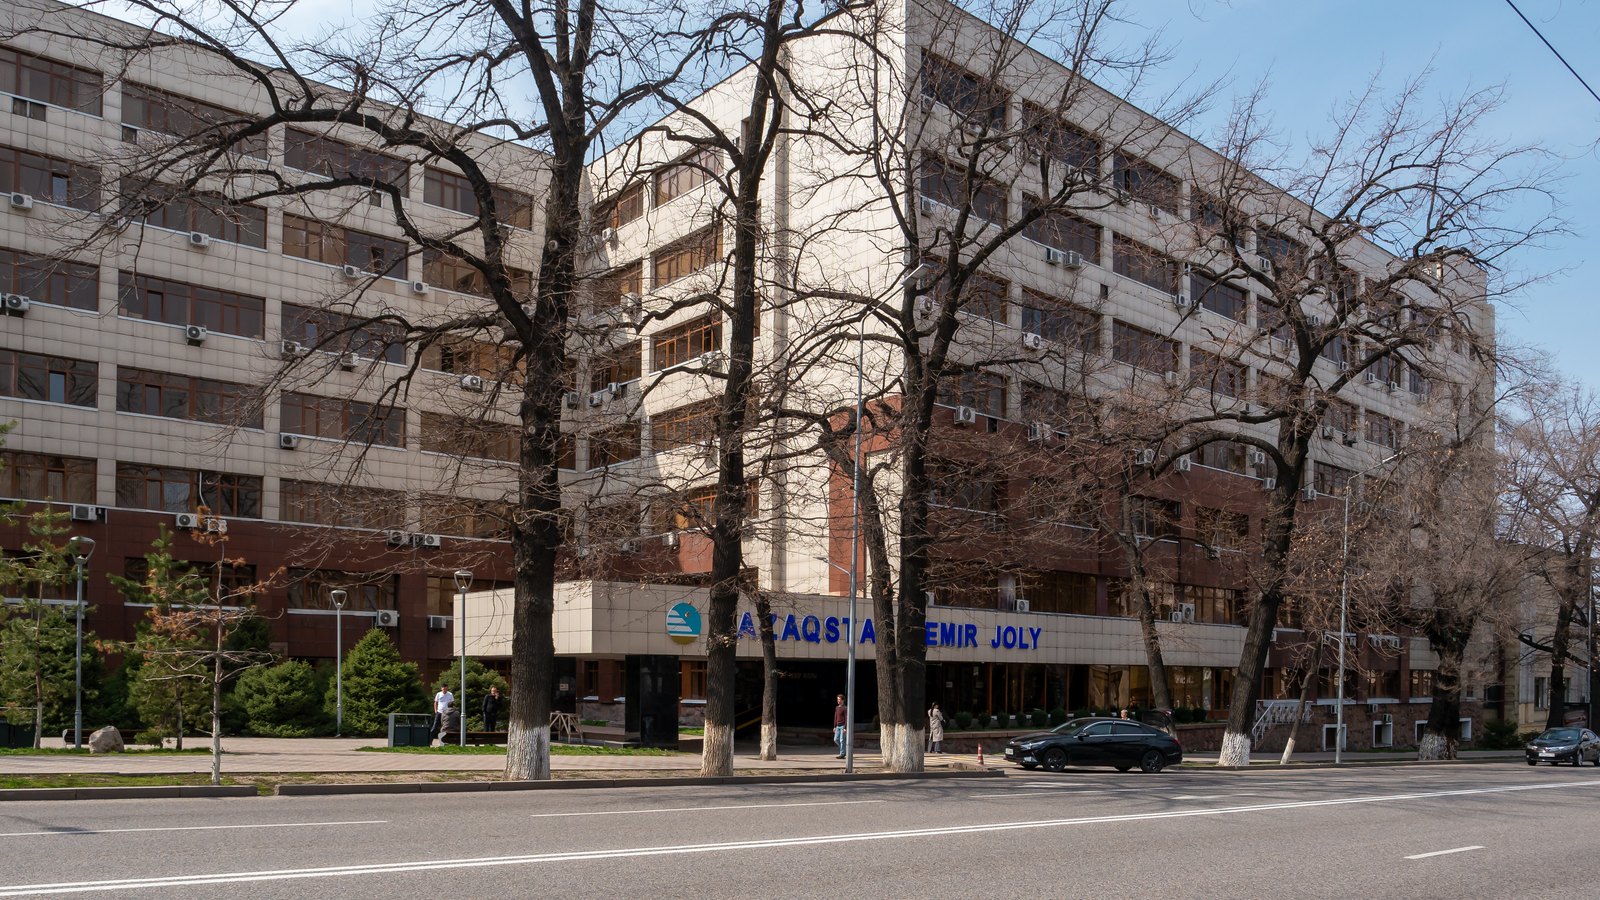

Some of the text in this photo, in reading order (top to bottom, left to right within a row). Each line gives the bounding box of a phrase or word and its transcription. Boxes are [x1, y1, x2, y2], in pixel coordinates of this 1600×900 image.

[735, 610, 1042, 649] AAQSTA EMIR JOLY
